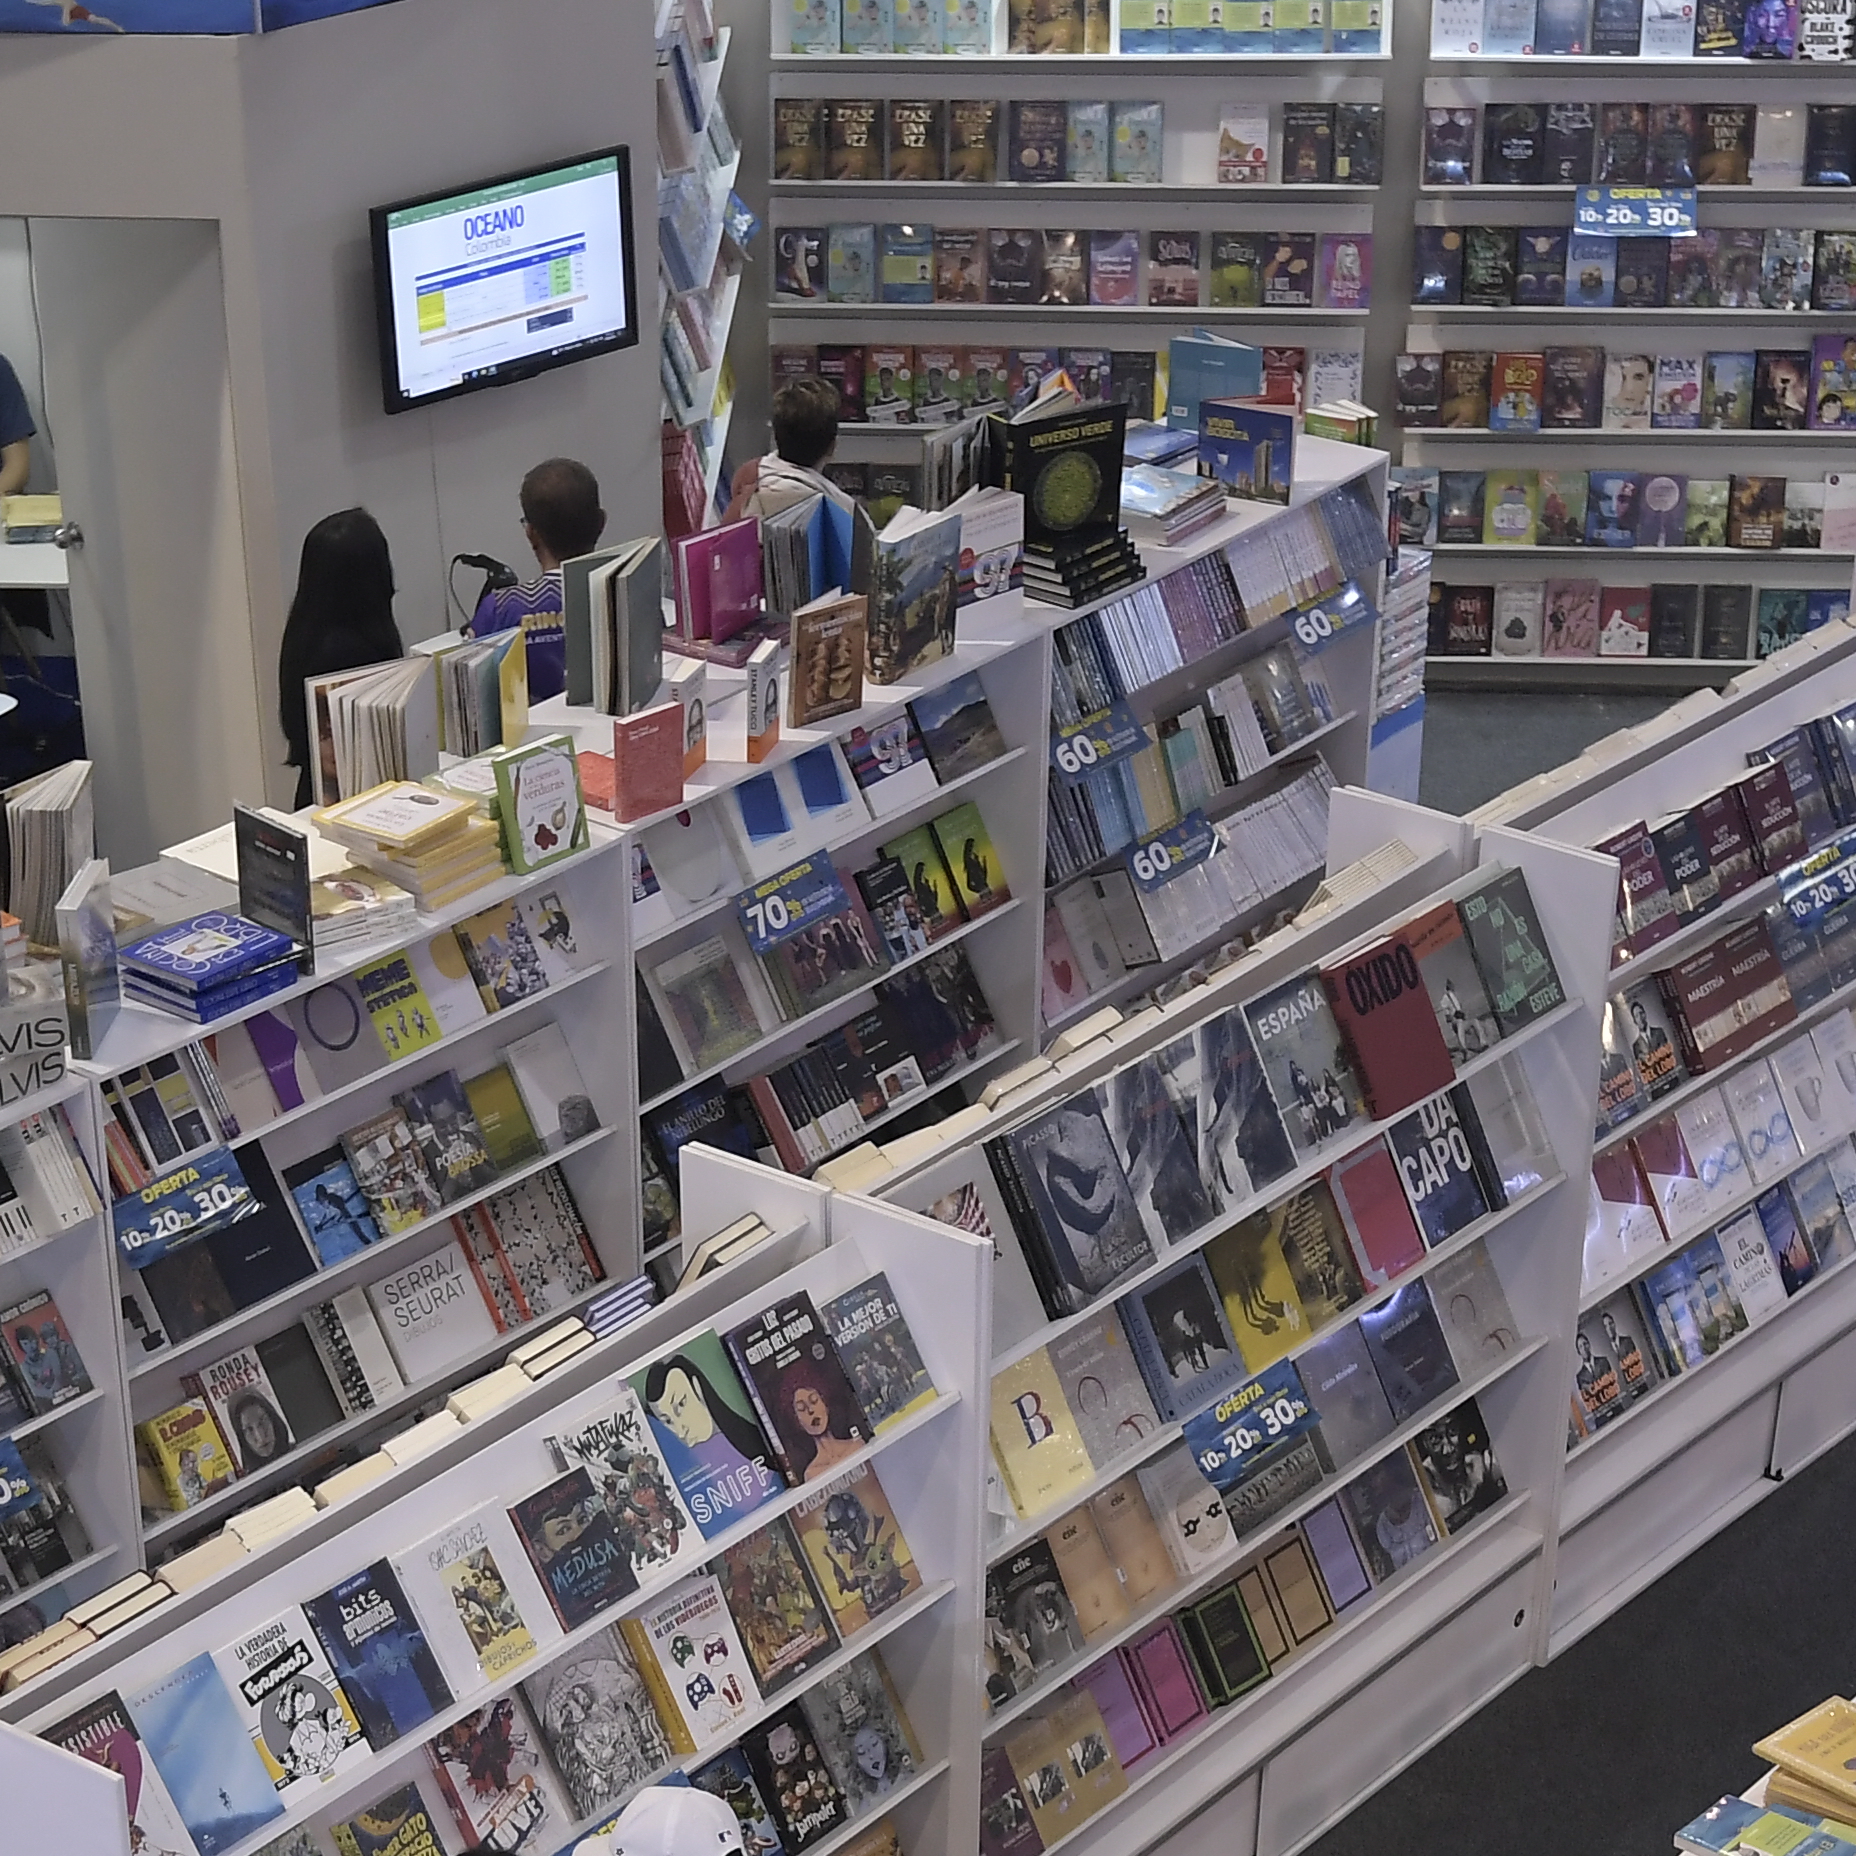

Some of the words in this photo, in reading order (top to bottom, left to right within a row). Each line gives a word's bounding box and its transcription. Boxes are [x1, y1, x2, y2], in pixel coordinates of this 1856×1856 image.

[1610, 188, 1662, 200] OFERTA
[463, 205, 526, 242] OCEANO
[465, 234, 512, 257] Colombia
[1659, 358, 1696, 375] MAX
[1030, 427, 1080, 448] UNIVERSO
[1081, 420, 1114, 438] VERDE
[749, 668, 758, 705] STANLEY
[1675, 861, 1701, 881] PODER
[1802, 848, 1841, 877] OFERTA
[1687, 975, 1725, 1003] MAESTRÍA
[1731, 950, 1771, 977] MAESTRÍA
[1257, 988, 1327, 1041] ESPAÑA
[1401, 1127, 1472, 1202] CAPO
[141, 1167, 200, 1203] OFERTA
[384, 1252, 458, 1304] SERRA/
[394, 1273, 468, 1328] SEURAT
[838, 1315, 852, 1332] LA
[851, 1299, 883, 1325] MEJOR
[871, 1310, 888, 1327] DE
[209, 1354, 248, 1382] RONDA
[210, 1366, 260, 1401] ROUSEY
[1010, 1389, 1055, 1450] B
[1215, 1382, 1266, 1423] OFERTA
[1260, 1398, 1306, 1436] 30%
[691, 1456, 769, 1525] SNIFF
[551, 1539, 619, 1593] MEDUSA
[340, 1589, 381, 1622] bits
[244, 1622, 287, 1656] VERDADERA
[493, 1640, 537, 1671] CAPRICHOS
[246, 1646, 280, 1671] HISTORIA
[399, 1812, 427, 1842] GATO
